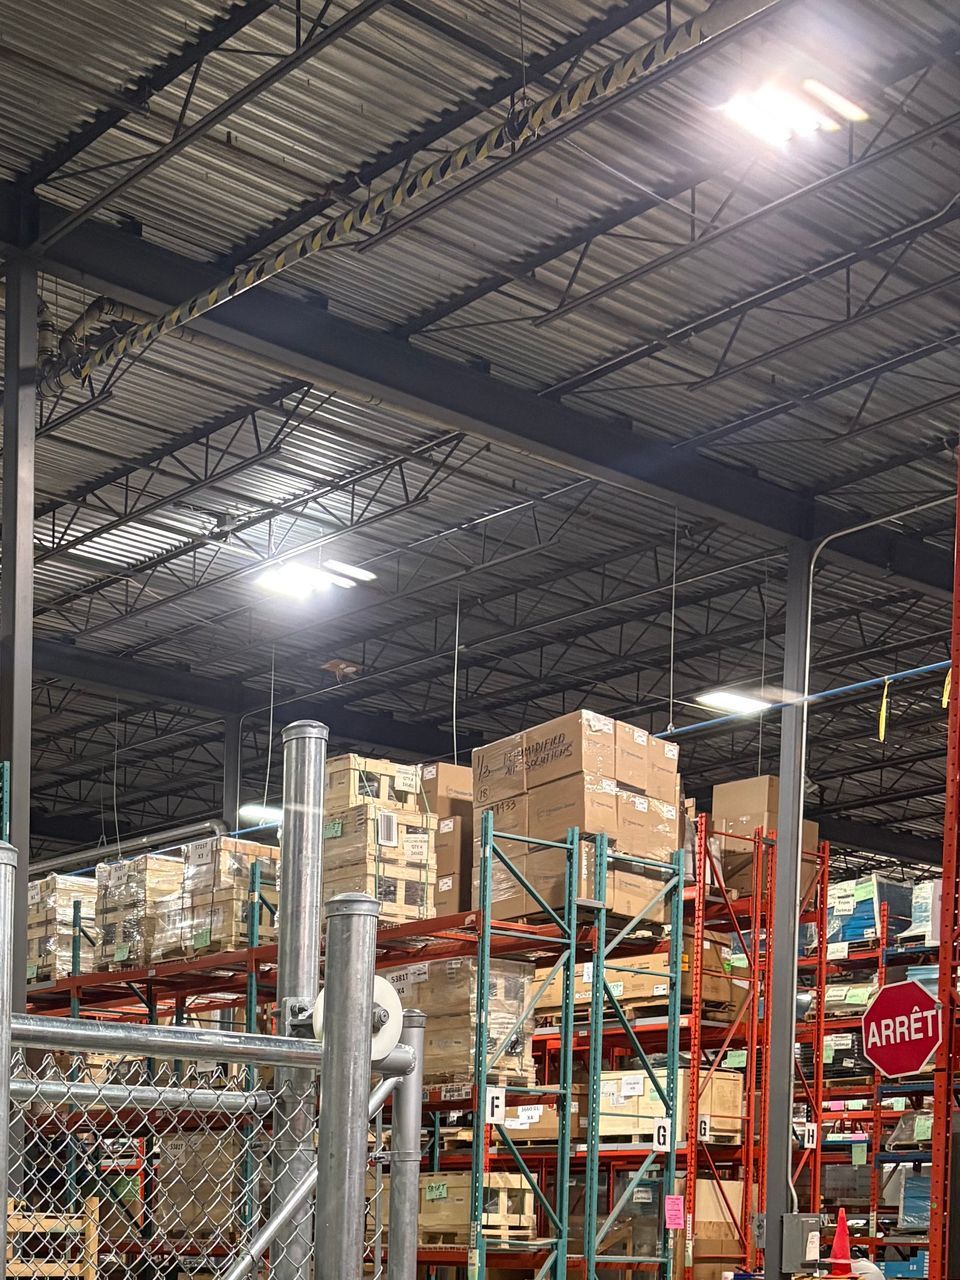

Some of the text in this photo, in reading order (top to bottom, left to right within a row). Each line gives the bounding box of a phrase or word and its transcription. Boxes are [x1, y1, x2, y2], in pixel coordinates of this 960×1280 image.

[525, 743, 573, 770] SOLUTIONS
[479, 788, 488, 799] 18
[867, 1005, 937, 1049] ARRÊT
[490, 1096, 500, 1117] F
[657, 1125, 667, 1146] G
[700, 1120, 707, 1137] G
[807, 1128, 815, 1144] H
